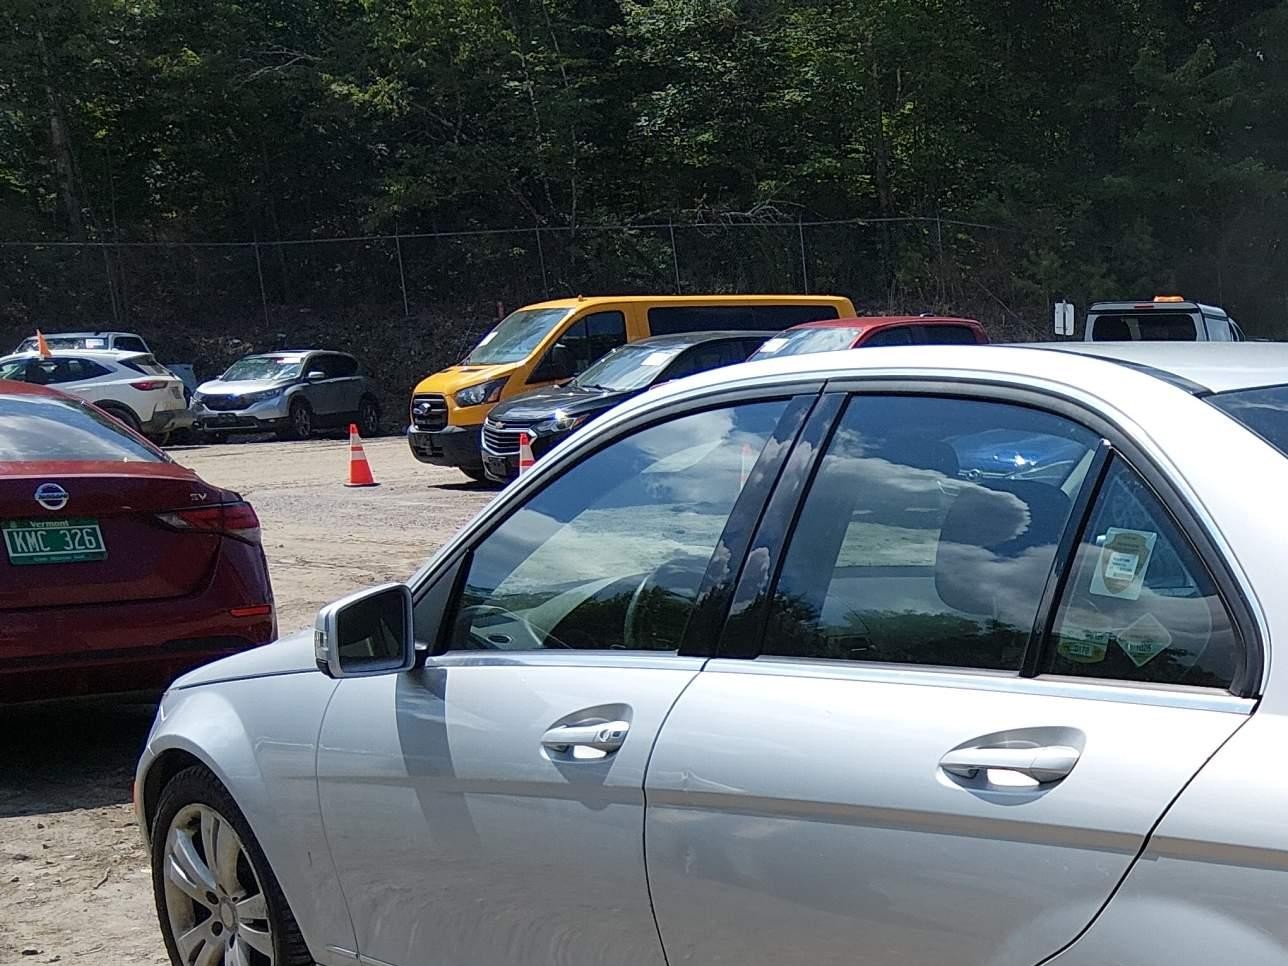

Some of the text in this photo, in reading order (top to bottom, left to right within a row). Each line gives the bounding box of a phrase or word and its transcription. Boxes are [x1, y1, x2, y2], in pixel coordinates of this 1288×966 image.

[30, 520, 69, 528] Vermont
[13, 528, 97, 553] KMC 326
